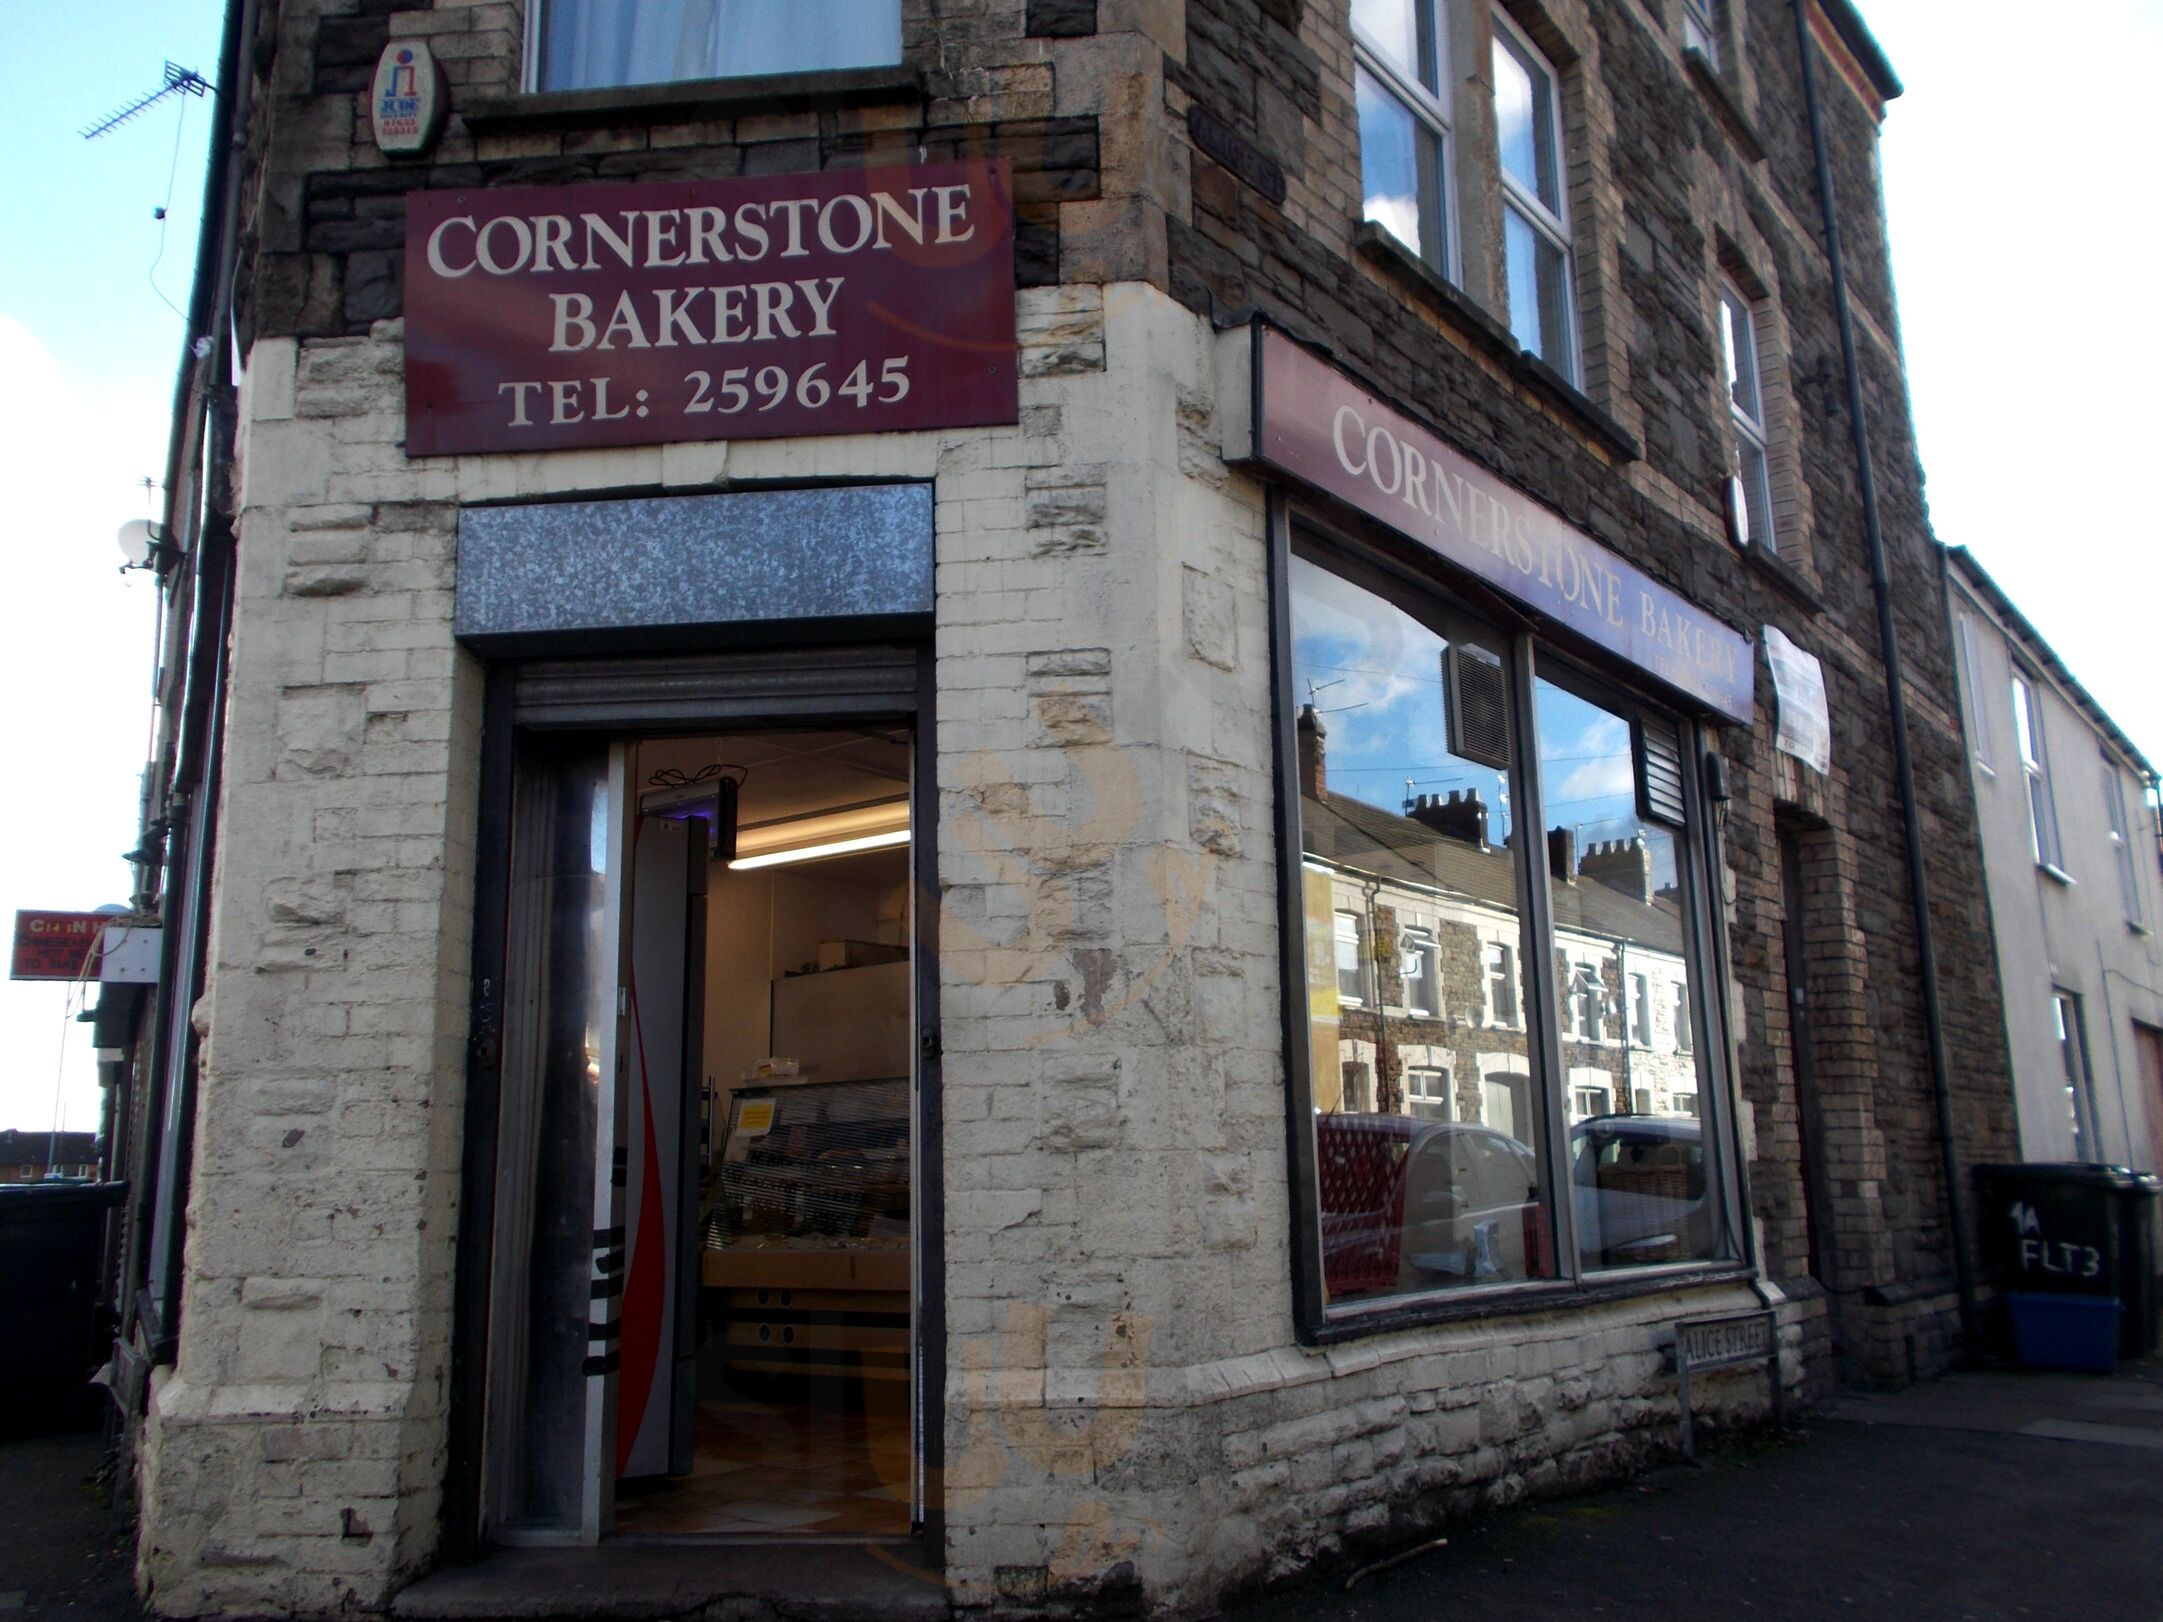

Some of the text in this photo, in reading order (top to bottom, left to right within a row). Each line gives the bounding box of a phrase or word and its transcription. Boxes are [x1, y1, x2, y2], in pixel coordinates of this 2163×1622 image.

[427, 184, 976, 279] CORNERSTONE
[548, 277, 846, 352] BAKERY
[498, 355, 911, 427] TEL: 259645
[1333, 405, 1738, 684] CORNERSTONE BAKERY
[1686, 1328, 1722, 1360] ALICE
